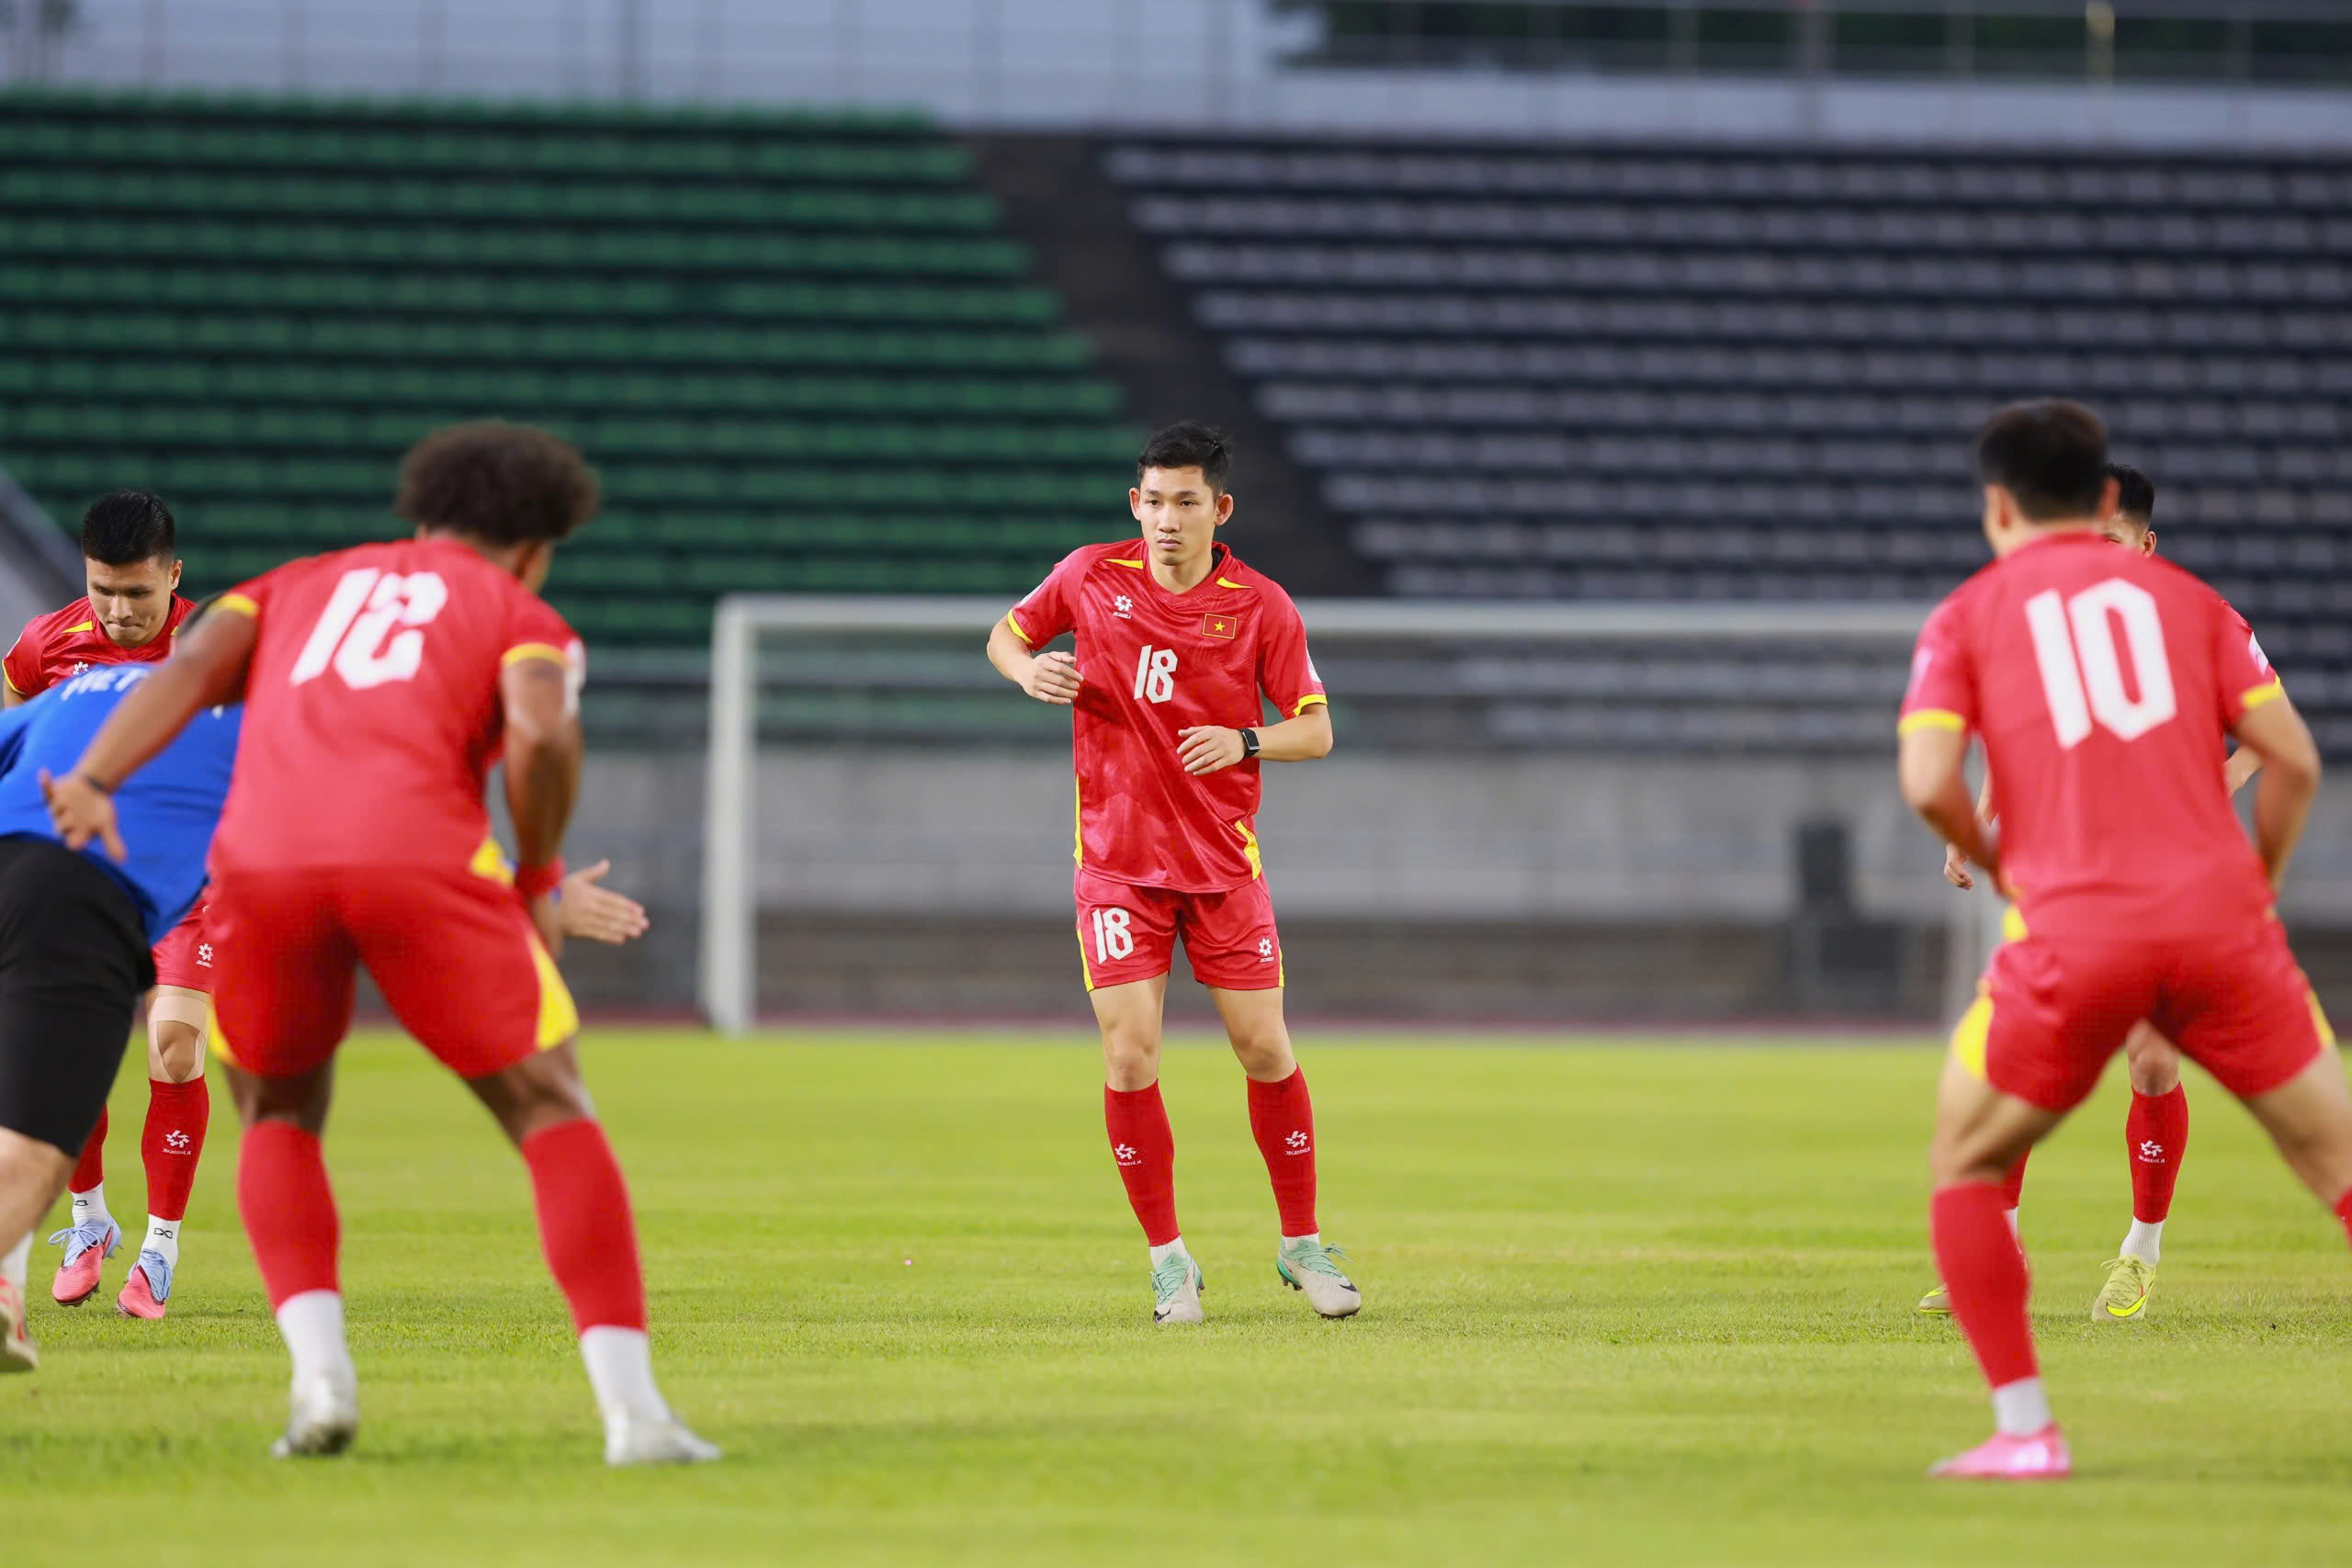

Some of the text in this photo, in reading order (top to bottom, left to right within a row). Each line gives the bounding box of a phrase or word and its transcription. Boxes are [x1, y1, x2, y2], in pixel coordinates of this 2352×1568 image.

[289, 567, 448, 690] 12
[1134, 644, 1178, 704] 18
[2025, 578, 2177, 749] 10
[1091, 907, 1134, 964] 18
